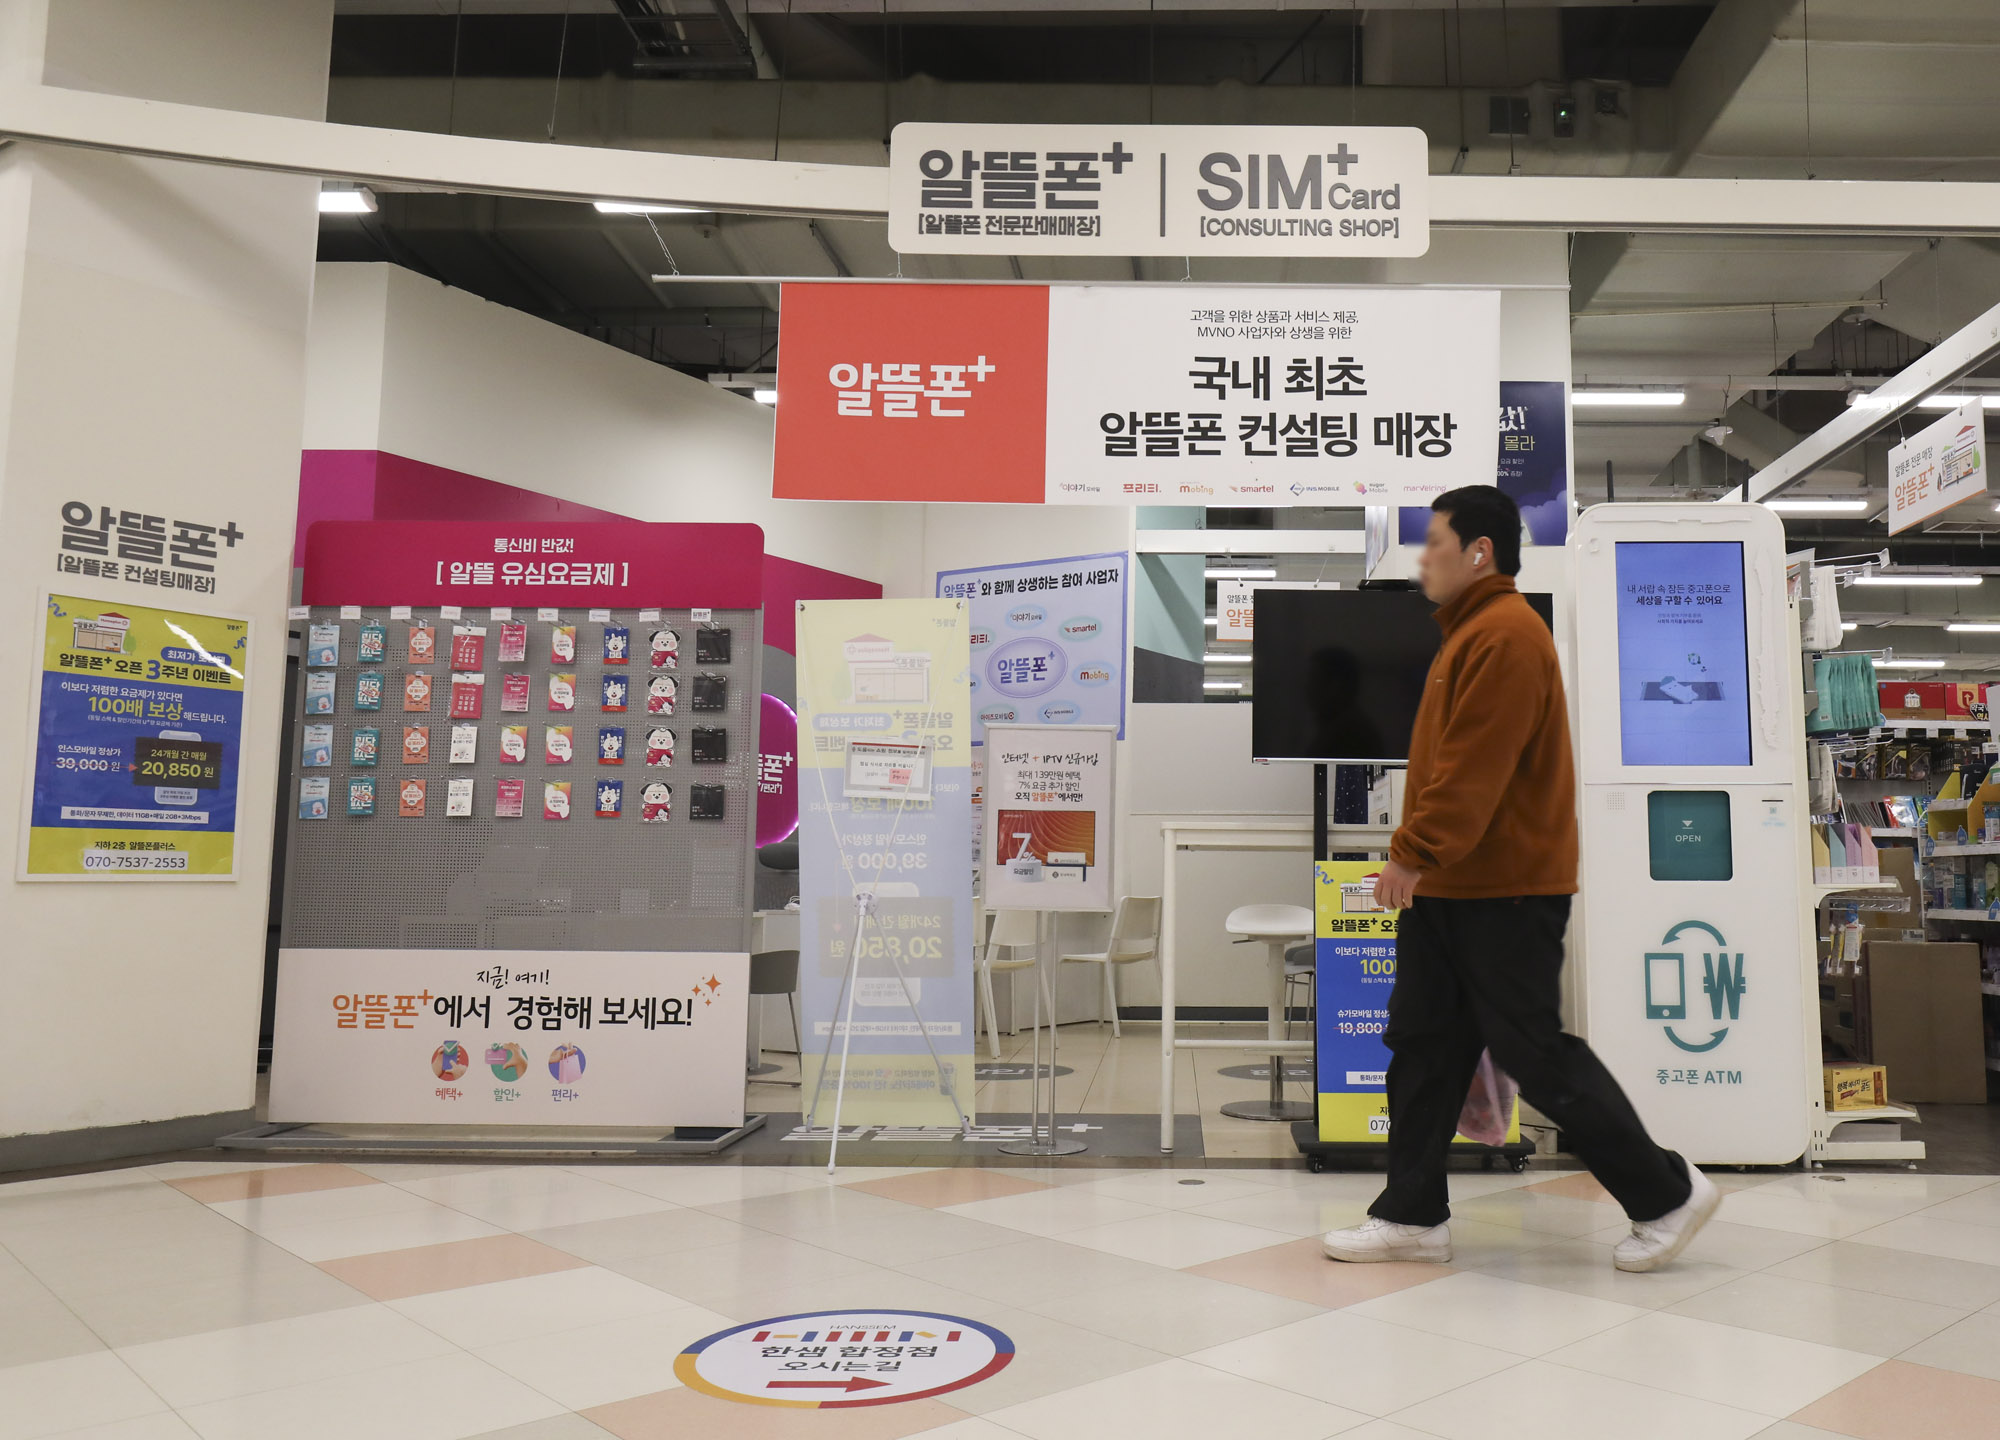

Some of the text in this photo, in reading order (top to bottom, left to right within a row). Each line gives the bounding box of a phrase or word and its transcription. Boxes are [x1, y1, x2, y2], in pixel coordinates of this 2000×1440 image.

[1328, 183, 1400, 210] Card
[918, 213, 1101, 237] [알뜰폰 전문판매매장]
[1200, 216, 1399, 239] [CONSULTING SHOP]
[1190, 310, 1359, 324] 고객을 위한 상품과 서비스 제공,
[1197, 326, 1352, 339] MVNO 사업자와 상생을 위한
[1188, 355, 1367, 401] 국내 최초
[1100, 411, 1457, 458] 알뜰폰 컨설팅 매장
[1504, 435, 1535, 451] 몰라
[1061, 484, 1086, 492] 이야기
[1240, 484, 1274, 493] smartel
[494, 538, 574, 553] 통신비 반값!
[57, 553, 216, 594] [알뜰폰 컨설팅매장]
[450, 562, 615, 586] 알뜰 유심요금제
[994, 579, 1014, 595] 함께
[1017, 575, 1058, 592] 상생하는
[1062, 572, 1082, 588] 참여
[1086, 569, 1118, 585] 사업자
[1627, 584, 1636, 594] 내
[1638, 584, 1655, 594] 서랍
[1657, 584, 1665, 594] 속
[1687, 584, 1731, 594] 중고폰으로
[1636, 595, 1723, 605] 세상을 구할 수 있어요
[1072, 624, 1097, 633] smartel
[168, 650, 196, 661] 최저가
[115, 659, 143, 675] 오픈
[146, 659, 188, 680] 3주년
[193, 668, 232, 684] 이벤트
[61, 681, 183, 702] 이보다 저렴한 요금제가 있다면
[88, 696, 227, 724] 100배 보상 해드립니다.
[57, 744, 121, 757] 인스모바일 정상가
[151, 749, 207, 761] 24개월 간 매월
[56, 757, 108, 772] 39,000
[1002, 753, 1029, 763] 인터넷
[1043, 755, 1062, 763] IPTV
[1065, 752, 1099, 766] 신규가입
[141, 761, 214, 779] 20,850 원
[1017, 770, 1032, 779] 최대
[1035, 771, 1063, 780] 139만원
[1019, 782, 1080, 791] 7% 요금 추가 할인
[1015, 792, 1030, 801] 오직
[1675, 834, 1702, 842] OPEN
[95, 841, 176, 850] 지하 2층 알뜰폰플러스
[86, 856, 185, 868] 070-7537-2553
[1335, 947, 1360, 957] 이보다
[1361, 947, 1387, 957] 저렴한
[515, 969, 551, 985] 여기!
[507, 996, 591, 1031] 경험해
[599, 997, 693, 1031] 보세요!
[1337, 1009, 1372, 1018] 슈가모바일
[1338, 1022, 1383, 1037] 19,800
[1360, 1074, 1384, 1082] 통화/문자
[1656, 1070, 1743, 1085] 중고폰 ATM
[762, 1346, 938, 1358] 한샘 합정점
